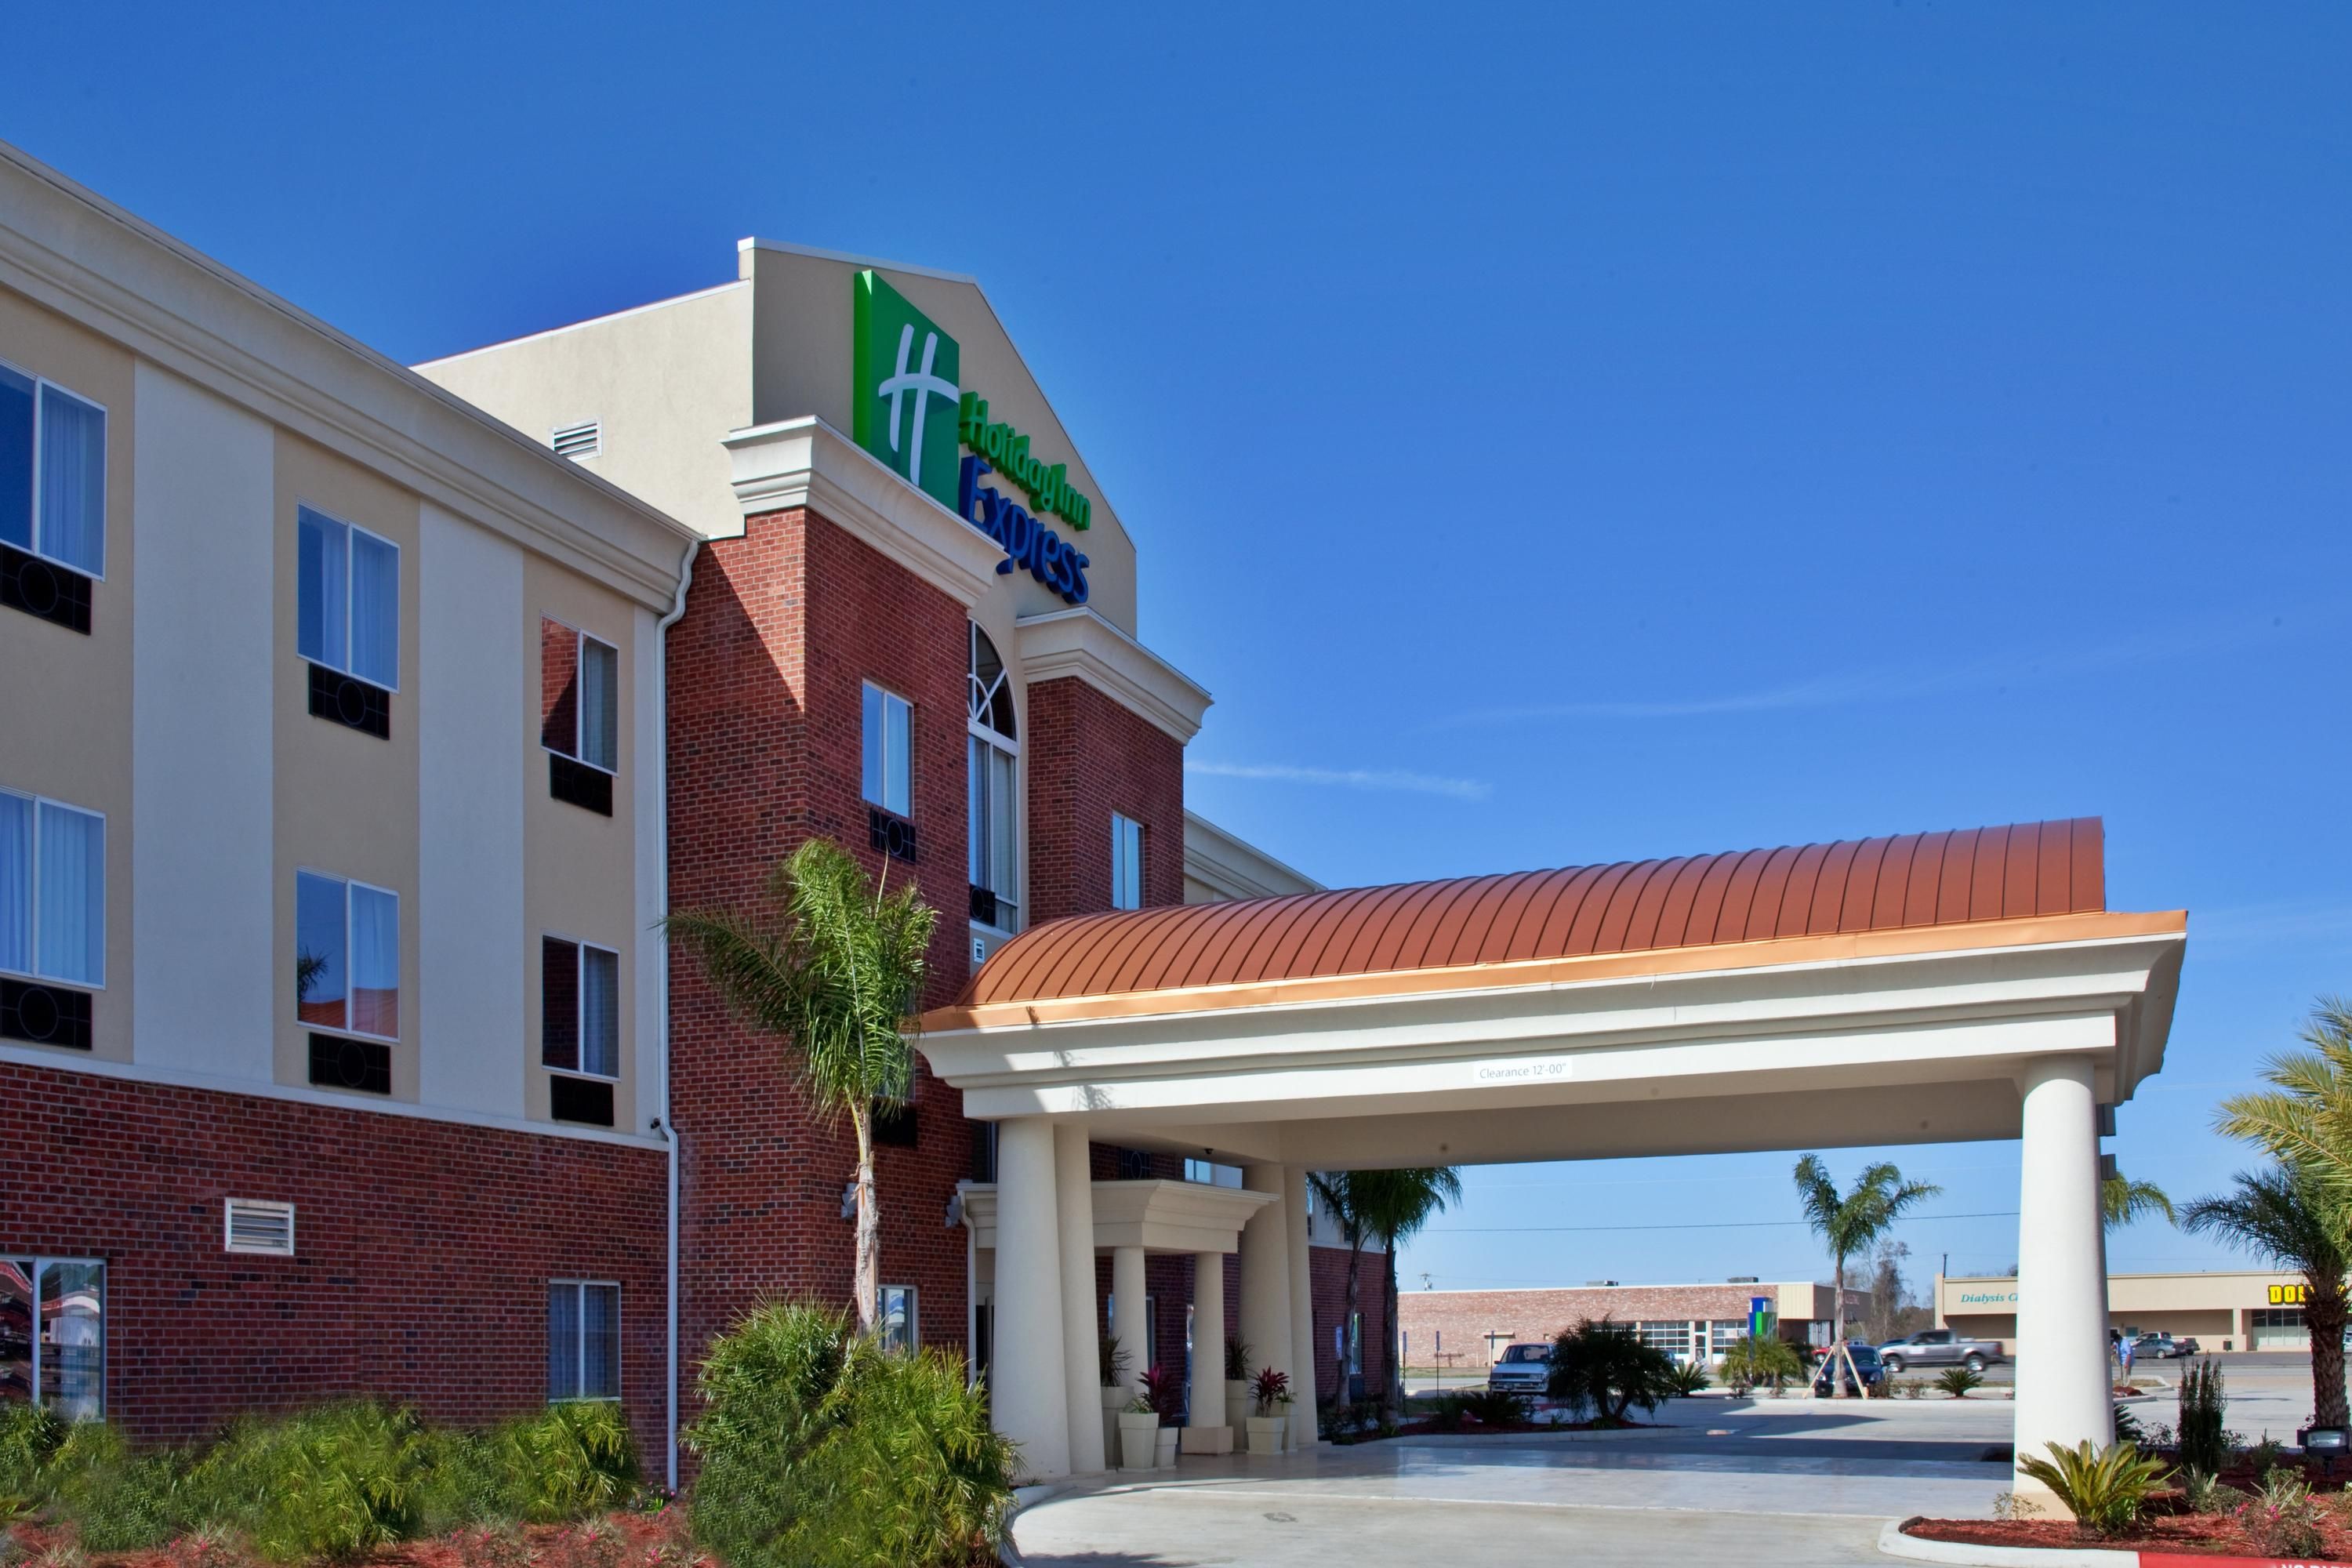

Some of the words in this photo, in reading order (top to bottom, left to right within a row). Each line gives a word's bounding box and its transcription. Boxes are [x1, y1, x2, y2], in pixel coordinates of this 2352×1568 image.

[960, 392, 1054, 512] Holiday
[1052, 463, 1091, 531] Inn
[960, 456, 1090, 604] Express
[1479, 1068, 1530, 1079] Clearance
[1961, 1293, 2005, 1305] Dialysis
